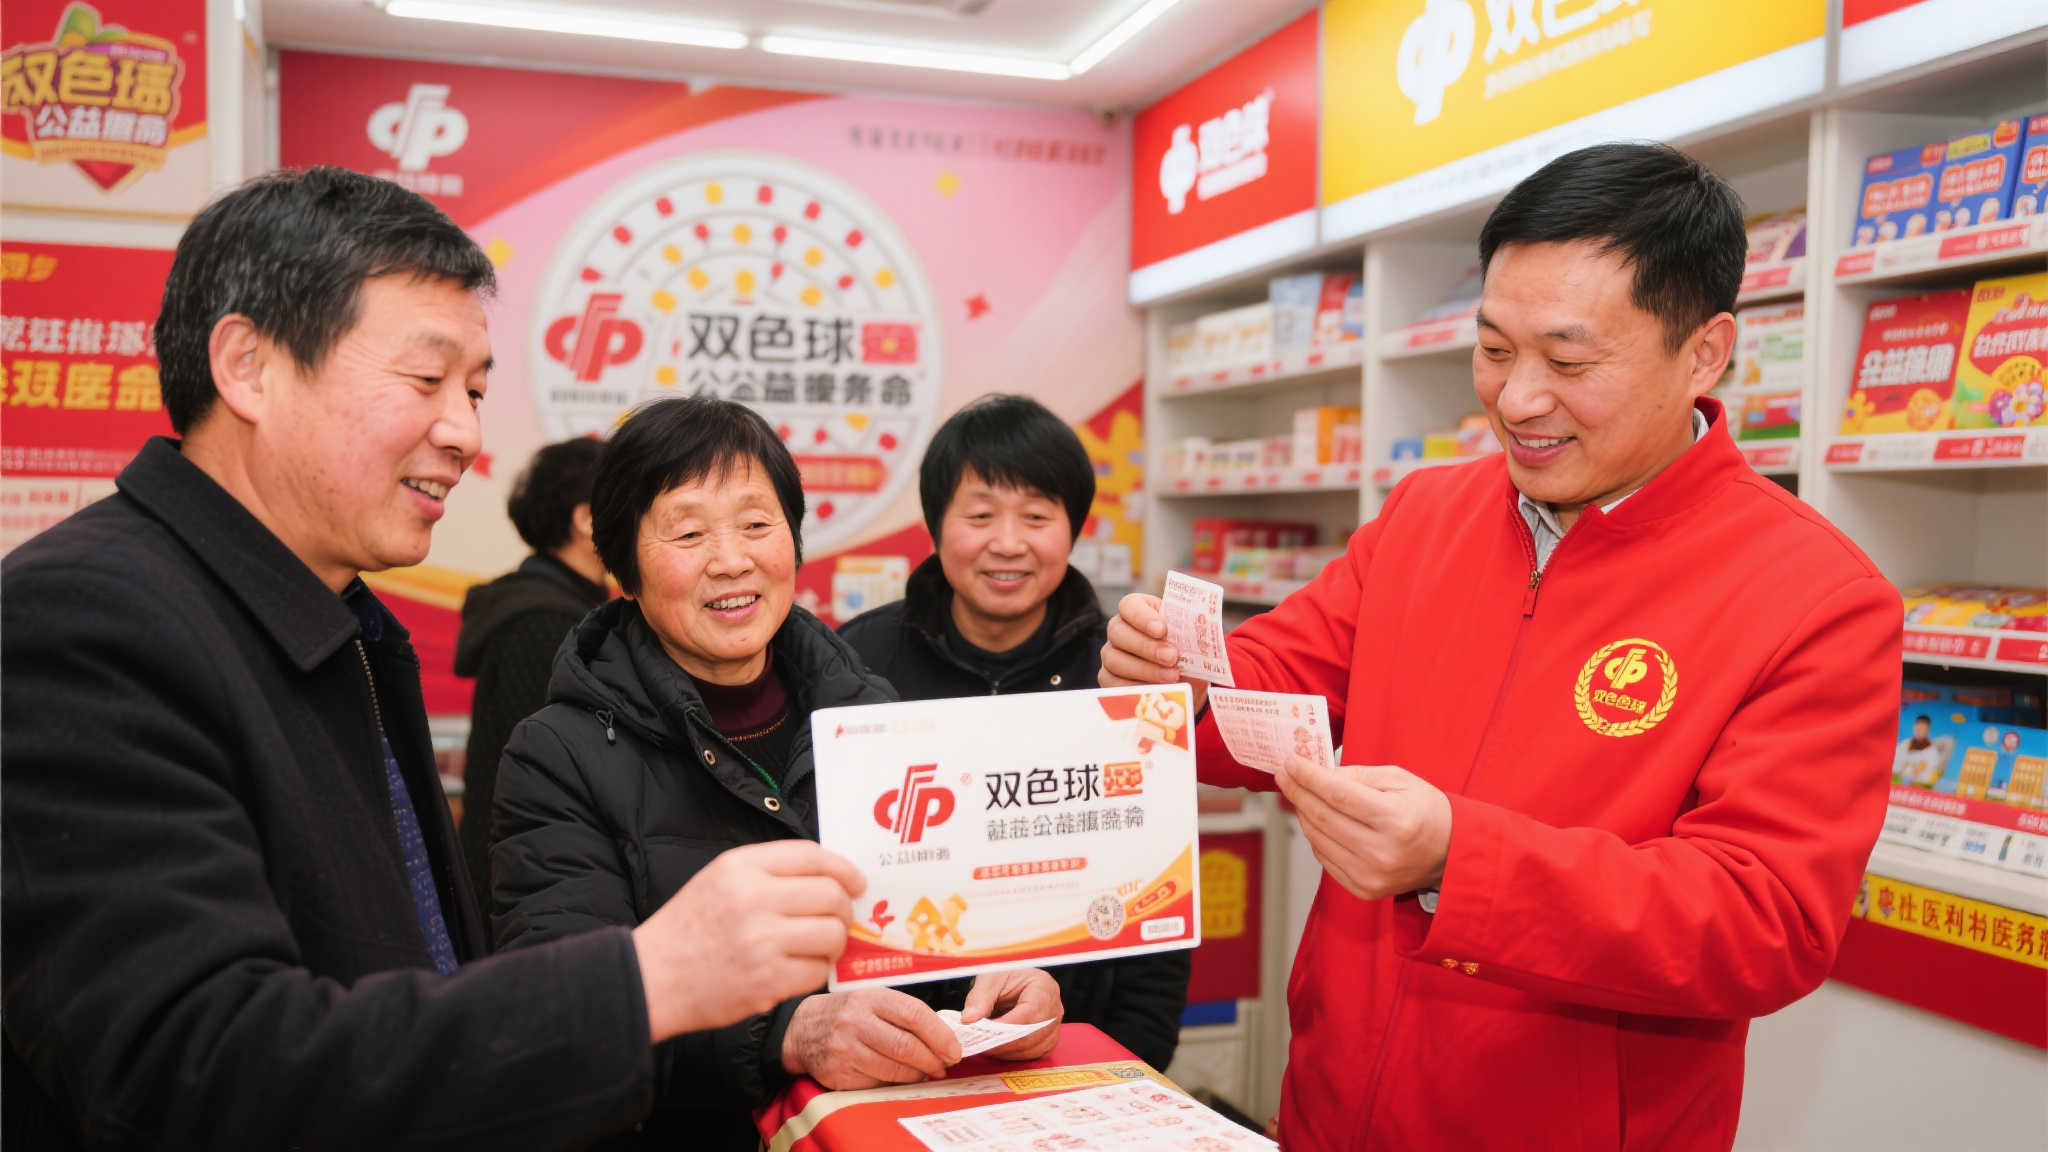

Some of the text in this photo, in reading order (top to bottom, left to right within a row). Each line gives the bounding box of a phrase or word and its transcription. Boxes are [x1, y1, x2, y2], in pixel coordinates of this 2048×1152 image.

[689, 313, 854, 365] 双色球
[983, 763, 1101, 811] 双色球
